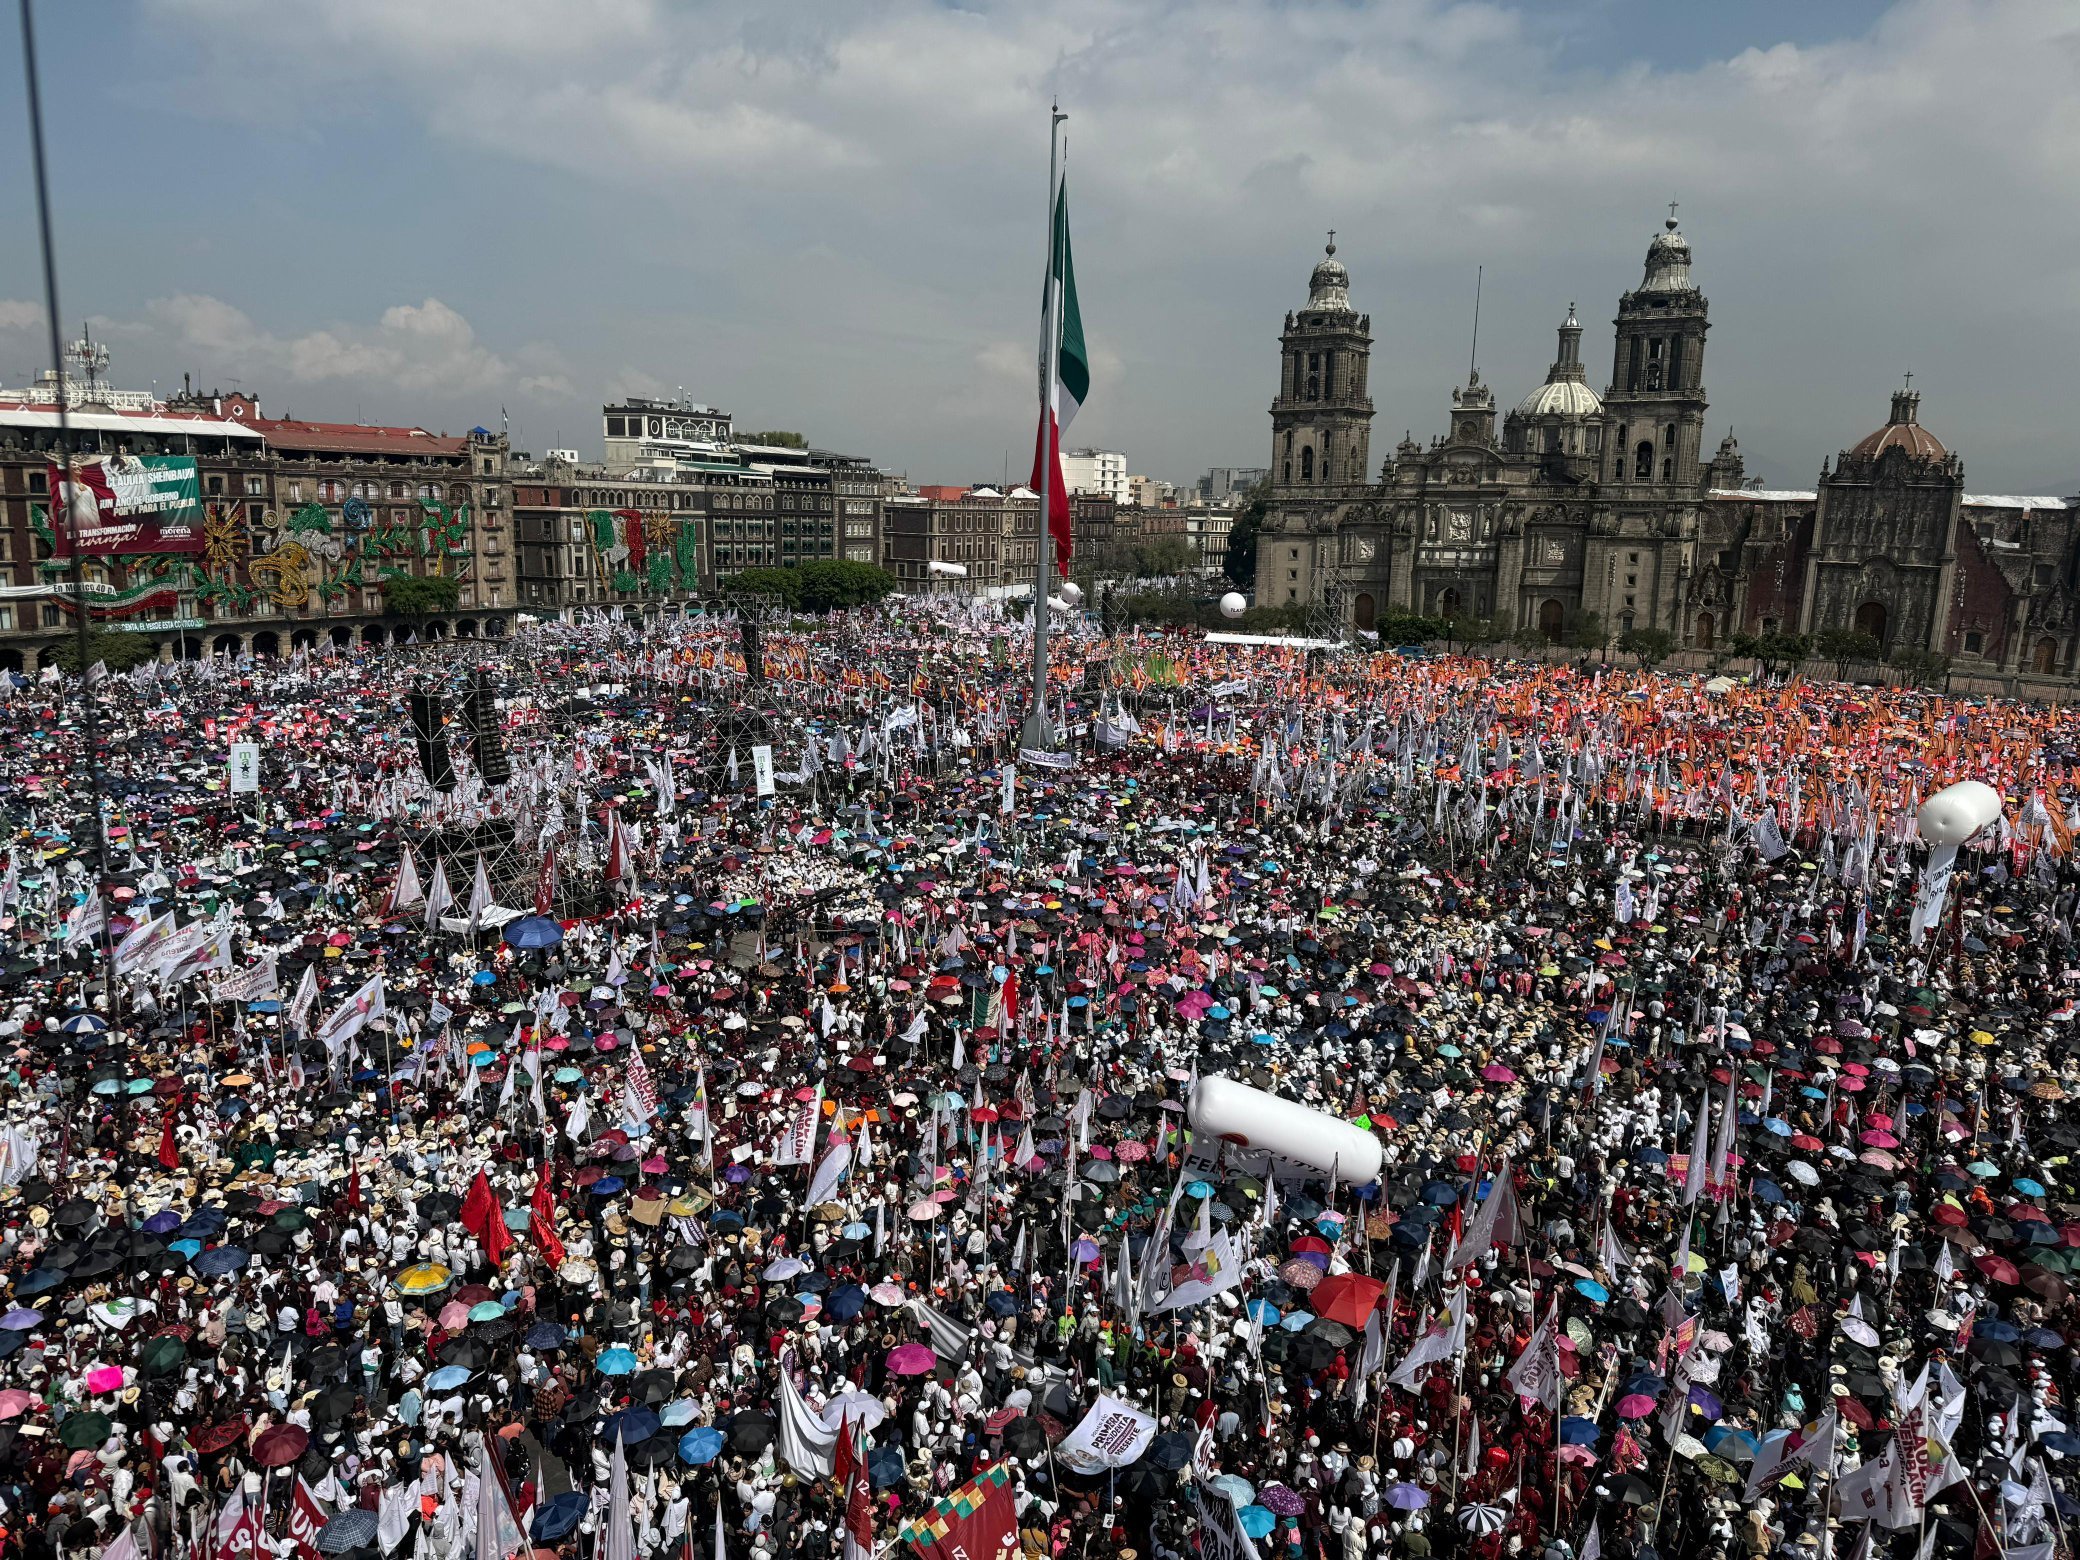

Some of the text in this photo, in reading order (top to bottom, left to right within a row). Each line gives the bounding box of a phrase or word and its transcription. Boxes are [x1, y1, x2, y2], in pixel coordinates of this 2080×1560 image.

[105, 467, 195, 488] CLAUDIA SHEINBAUM
[115, 495, 130, 507] AÑO
[145, 490, 179, 503] GOBIERNO
[113, 506, 129, 516] POR
[138, 503, 158, 513] PARA
[79, 523, 137, 538] TRANSFORMACIÓN
[160, 527, 192, 535] morena
[53, 584, 63, 592] En
[96, 584, 106, 593] 40
[626, 1061, 655, 1114] EINBAUM
[1091, 1412, 1123, 1450] PRIMERA
[1115, 1427, 1141, 1456] PRESENTE
